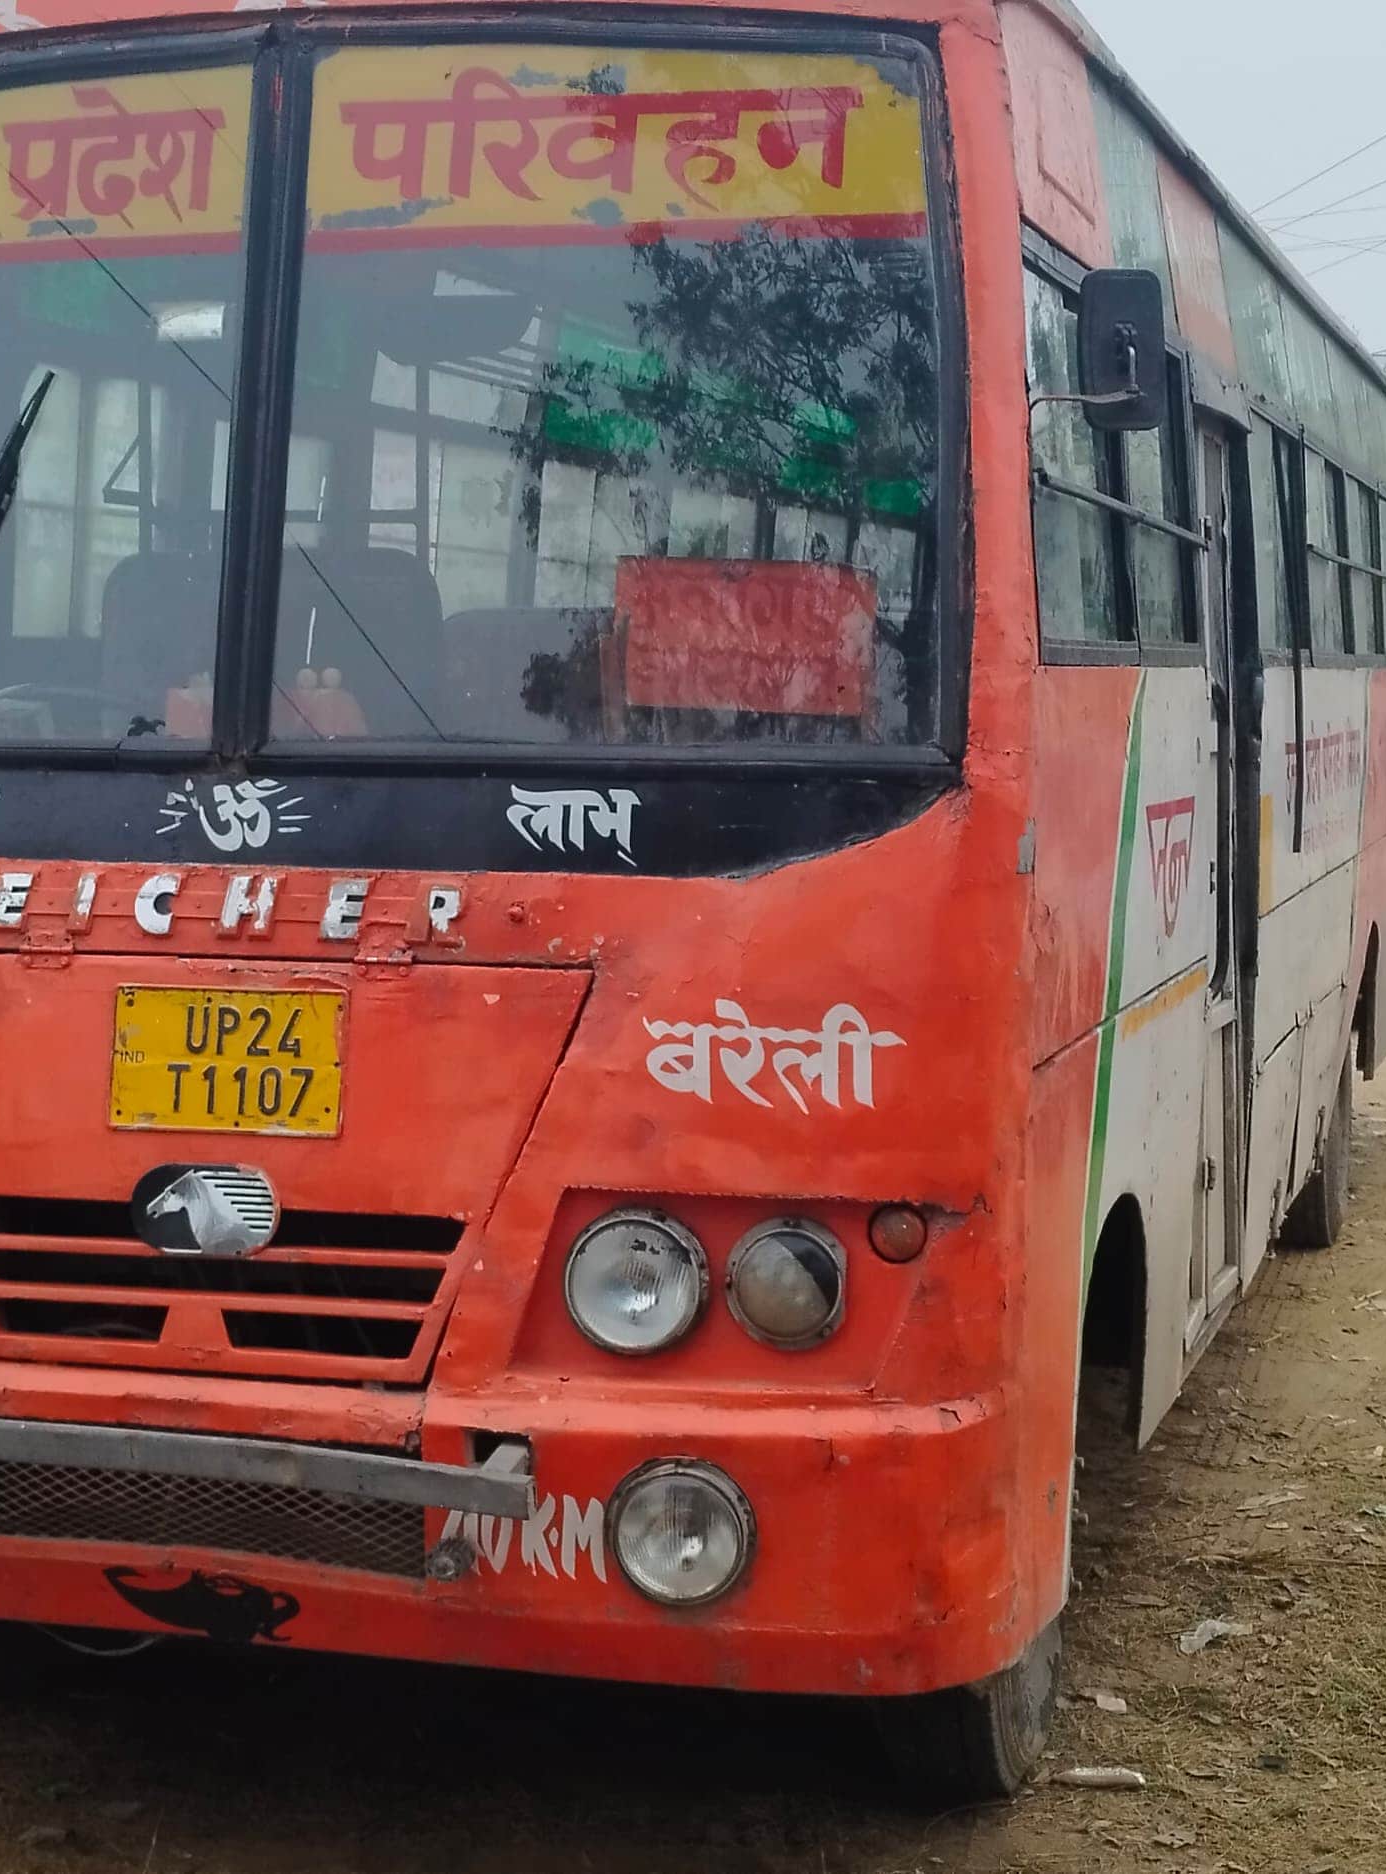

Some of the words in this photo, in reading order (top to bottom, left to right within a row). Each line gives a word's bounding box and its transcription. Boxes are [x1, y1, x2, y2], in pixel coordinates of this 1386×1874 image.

[1, 85, 224, 230] प्रदेश
[339, 67, 864, 212] परिवहन
[507, 784, 641, 866] लाभ
[184, 1003, 305, 1059] UP24
[642, 998, 908, 1115] बरेली
[167, 1063, 315, 1119] T1107
